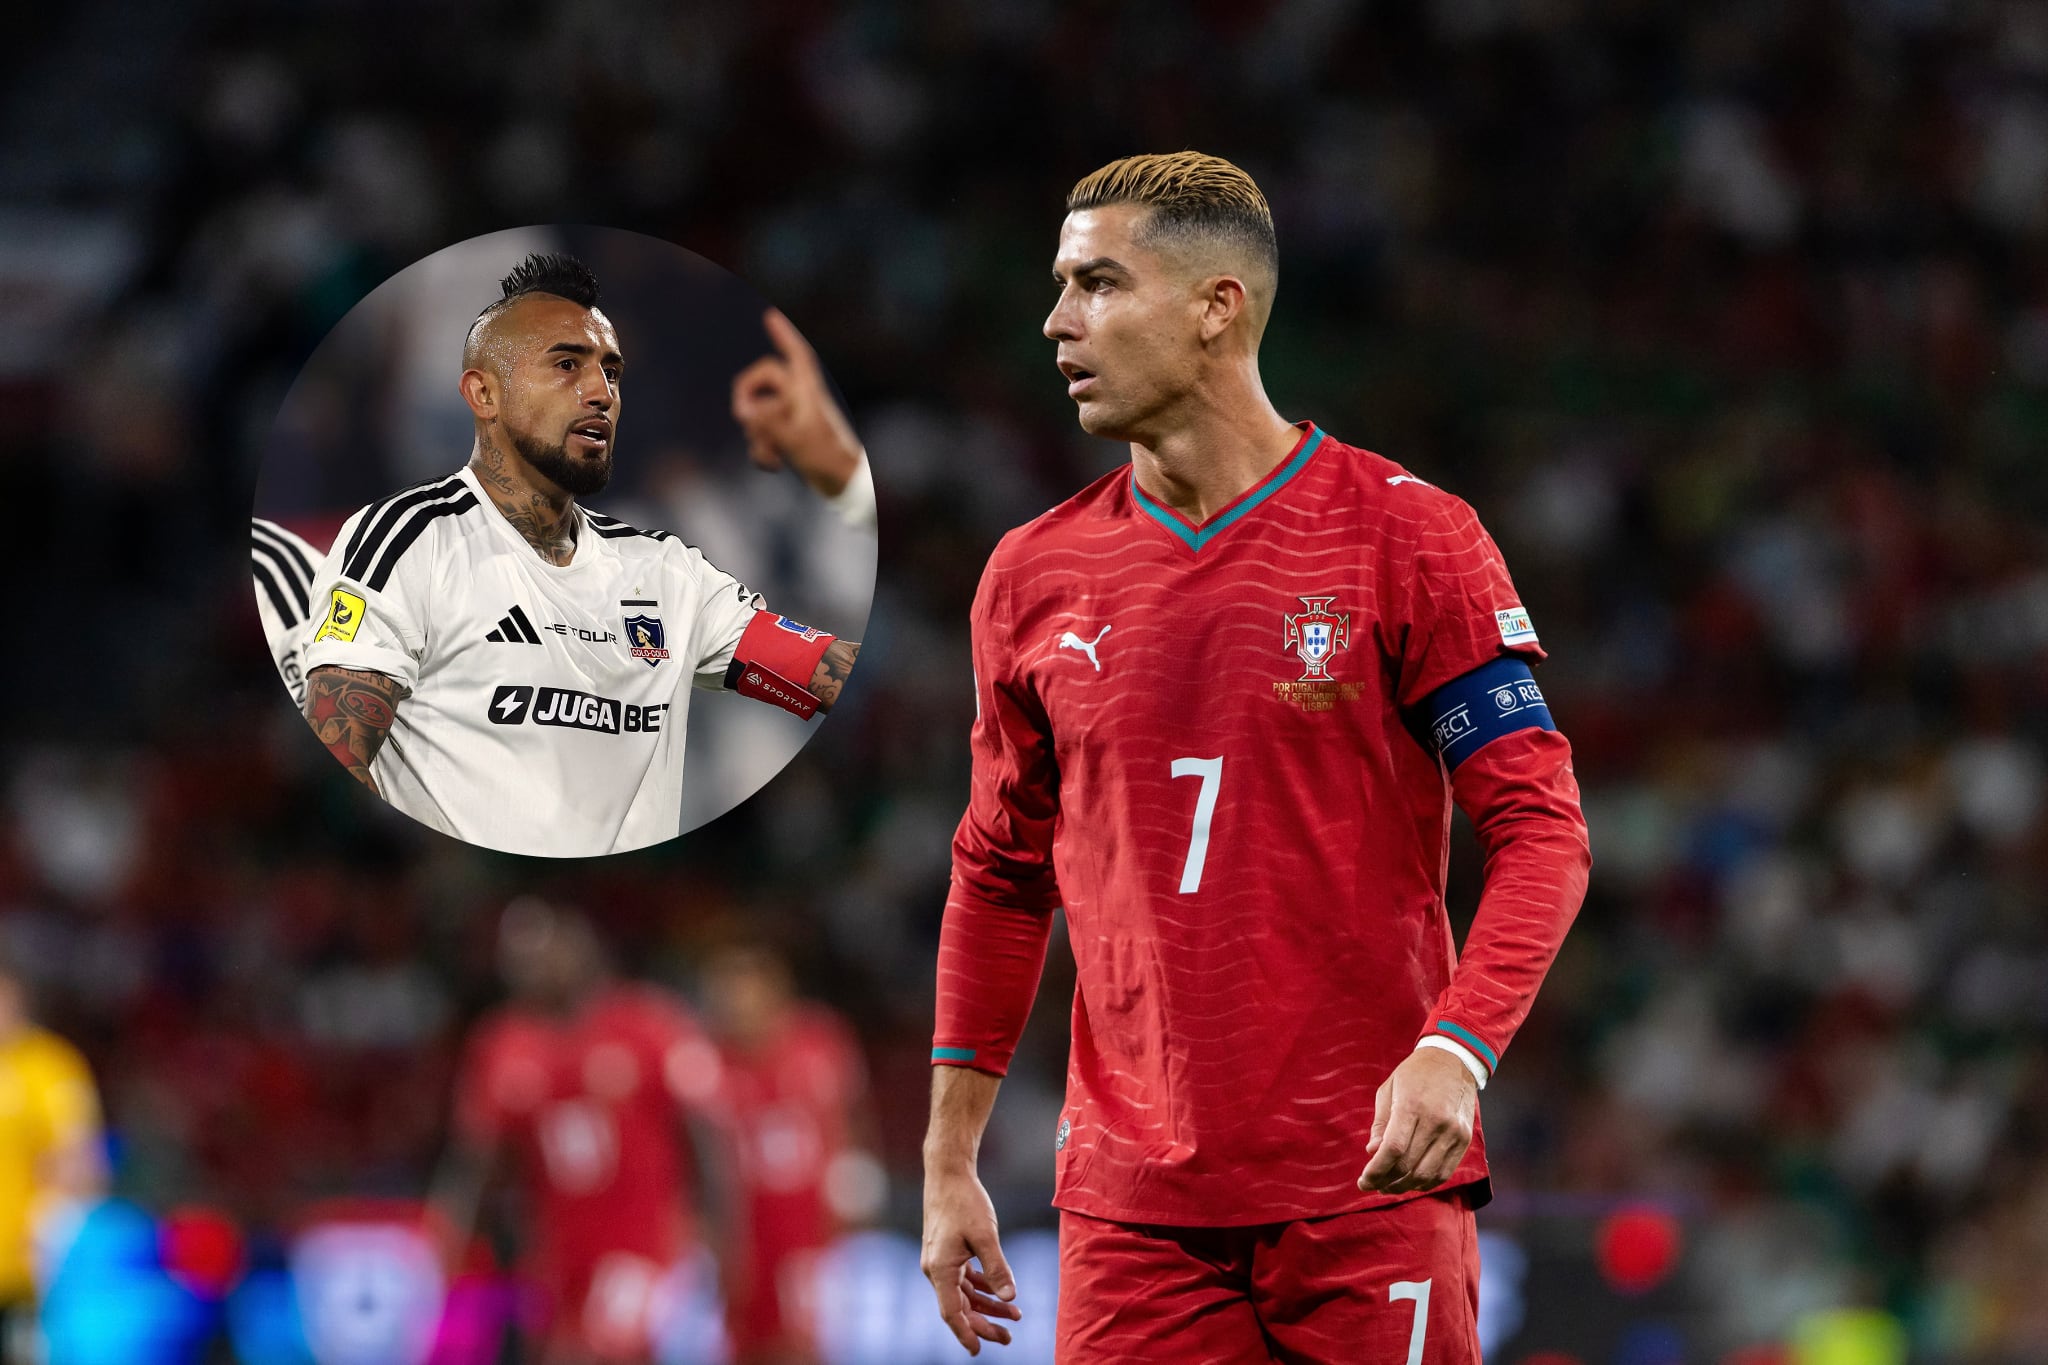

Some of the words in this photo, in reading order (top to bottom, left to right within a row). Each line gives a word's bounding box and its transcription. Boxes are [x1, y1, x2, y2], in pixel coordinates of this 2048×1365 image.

[631, 648, 669, 659] COLO-COLO
[1292, 692, 1336, 703] SETEMBRO
[1302, 701, 1334, 712] LISBOA
[1171, 755, 1224, 894] 7
[1388, 1277, 1432, 1365] 7
